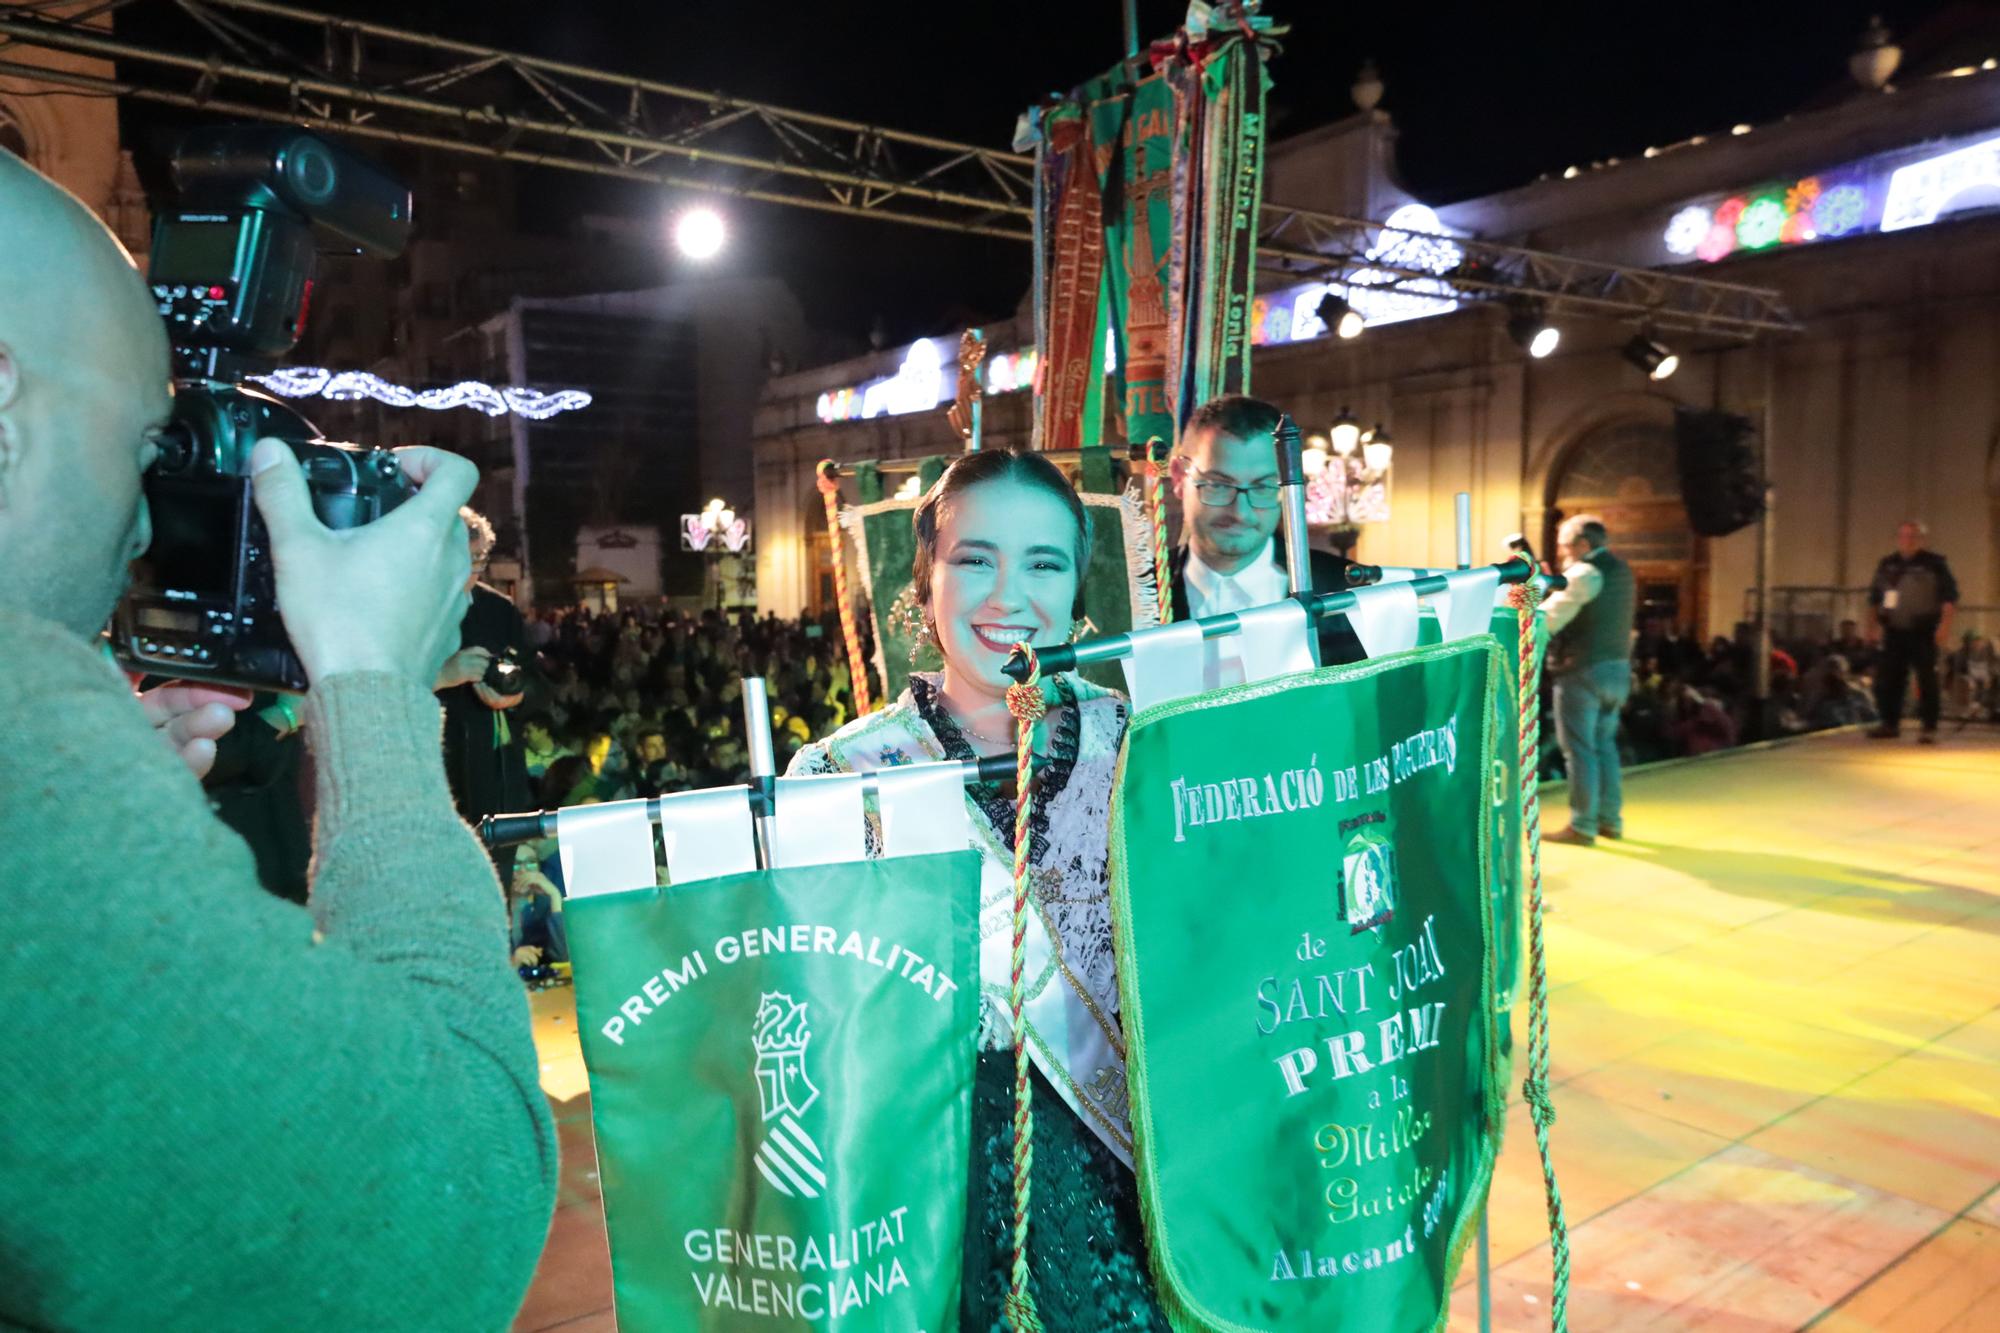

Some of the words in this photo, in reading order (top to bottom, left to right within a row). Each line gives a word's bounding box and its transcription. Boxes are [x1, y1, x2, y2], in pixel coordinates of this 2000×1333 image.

[1226, 293, 1246, 358] Sonia
[1170, 753, 1324, 842] FEDERACIÓ
[1333, 765, 1358, 802] DE
[1363, 755, 1390, 794] LES
[1256, 963, 1374, 1036] SANT
[1388, 914, 1446, 1001] JOAN
[1296, 932, 1326, 962] de
[602, 950, 708, 1046] PREMI
[715, 925, 959, 1003] GENERALITAT
[1272, 1002, 1446, 1098] PREMI
[1368, 1090, 1381, 1110] a
[1391, 1074, 1408, 1101] la
[684, 1206, 907, 1271] GENERALITAT
[1270, 1224, 1416, 1281] Alacant
[691, 1257, 911, 1320] VALENCIANA
